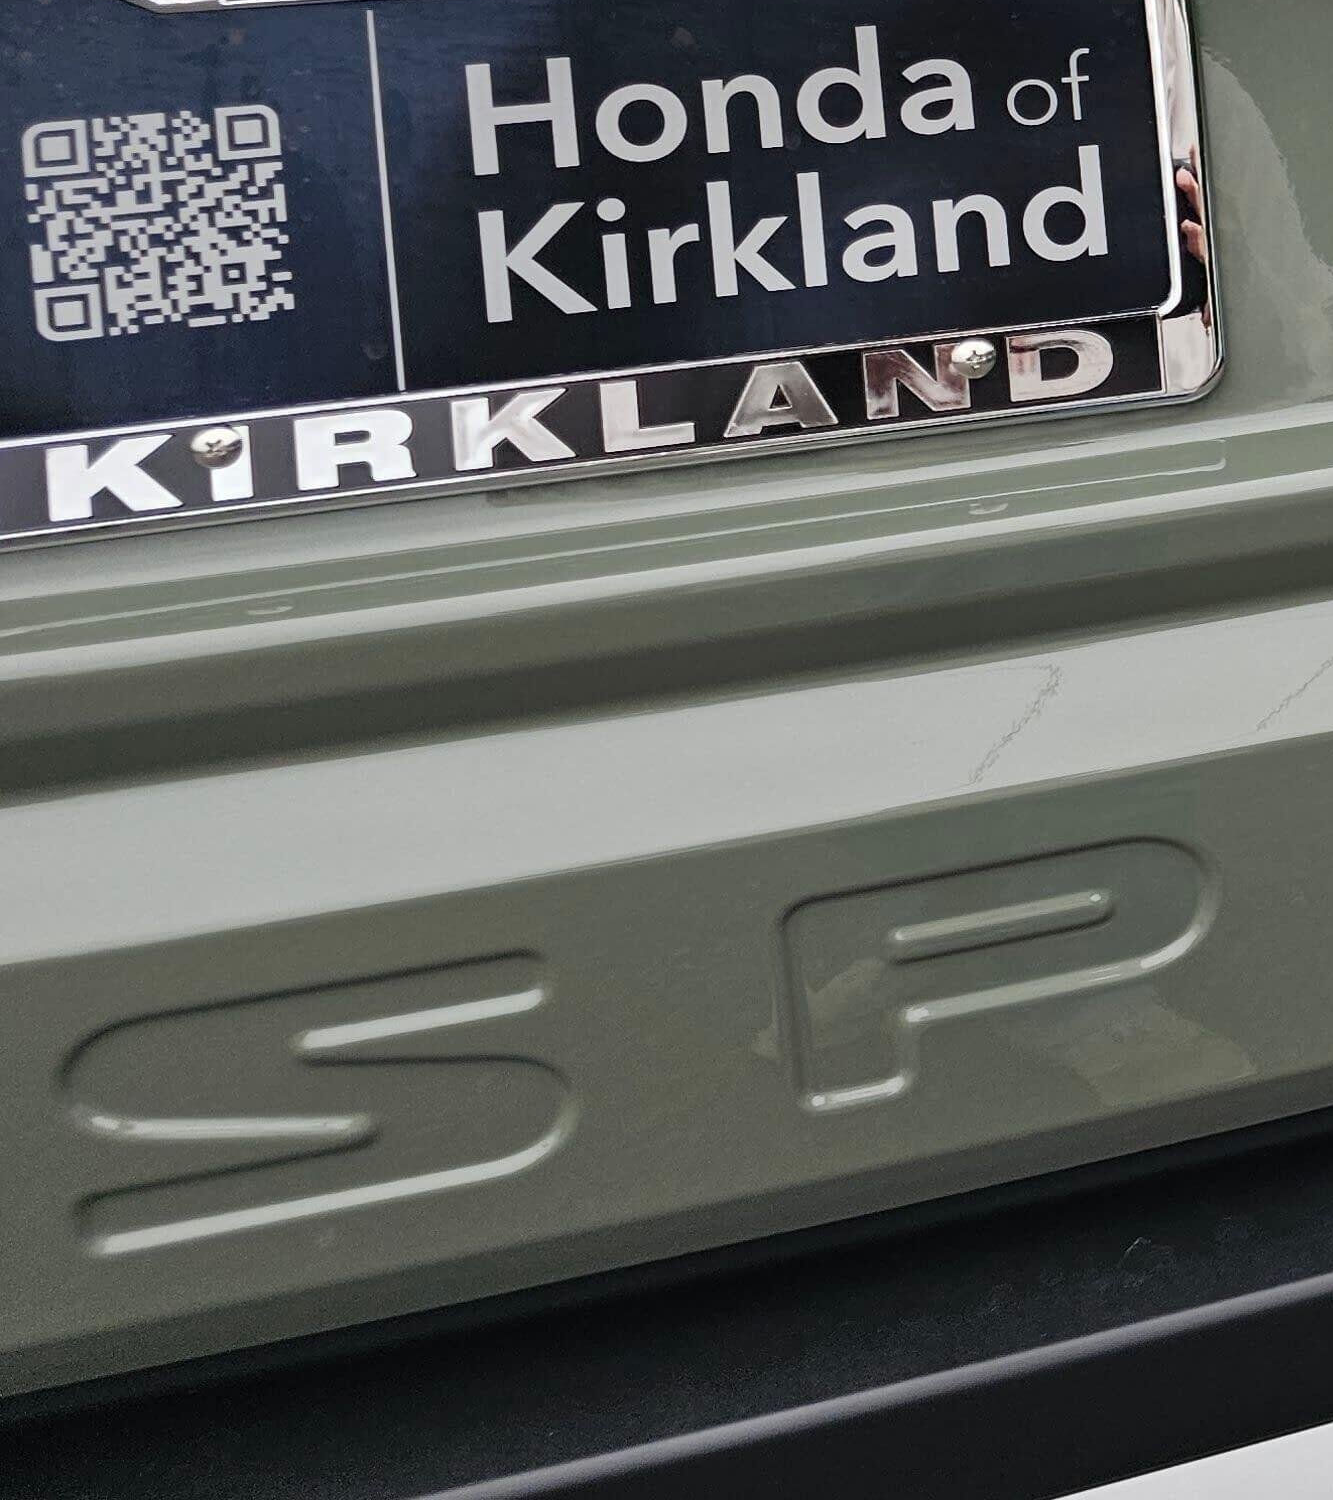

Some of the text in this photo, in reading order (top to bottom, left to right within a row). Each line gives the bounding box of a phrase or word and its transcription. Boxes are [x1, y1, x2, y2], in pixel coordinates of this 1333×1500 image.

[464, 25, 1090, 177] Honda of
[477, 144, 1109, 324] Kirkland
[44, 329, 1114, 523] KIRKLAND
